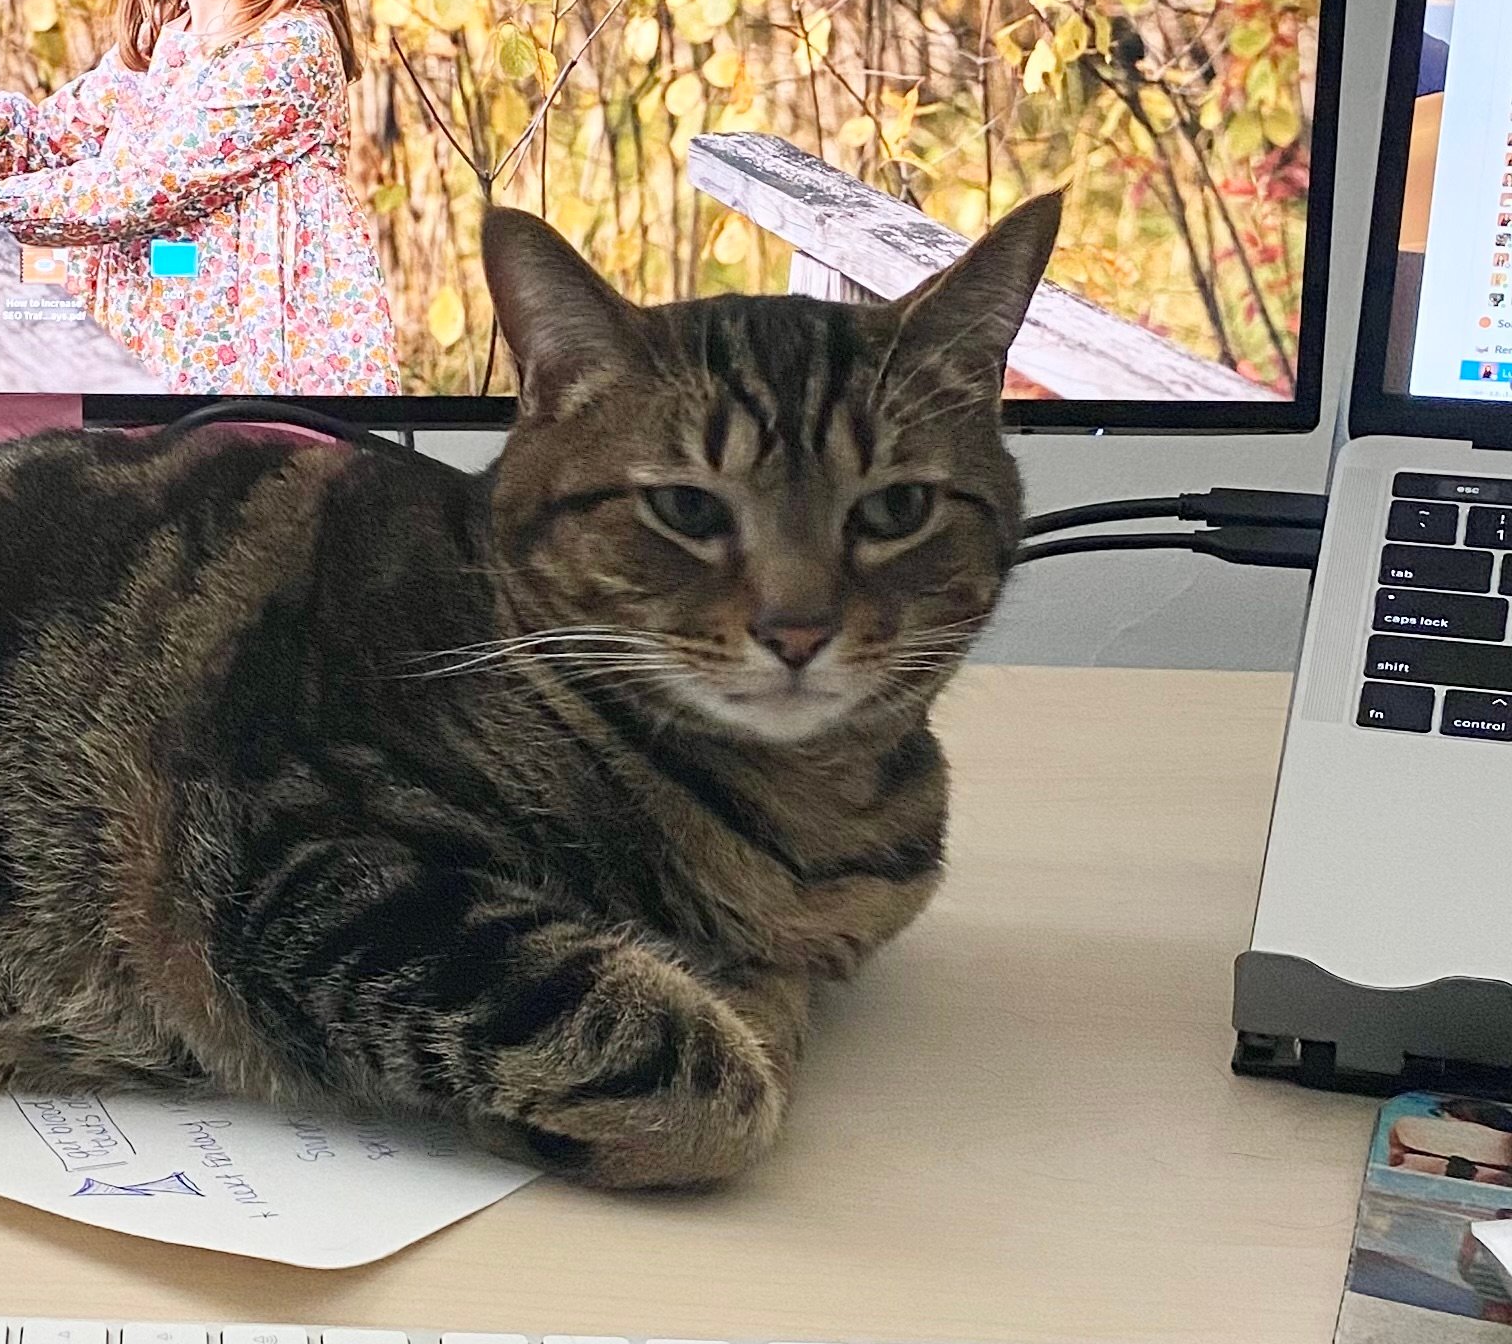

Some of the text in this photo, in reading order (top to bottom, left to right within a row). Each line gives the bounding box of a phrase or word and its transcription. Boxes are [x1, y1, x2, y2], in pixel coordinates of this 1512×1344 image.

[6, 299, 84, 308] How to Increase
[2, 311, 23, 321] SEO
[1456, 485, 1480, 495] esc
[1496, 528, 1504, 541] 1
[1390, 568, 1414, 580] tab
[1383, 614, 1449, 629] caps lock
[1376, 661, 1410, 674] shift
[1369, 709, 1384, 720] fn
[1452, 717, 1506, 733] control
